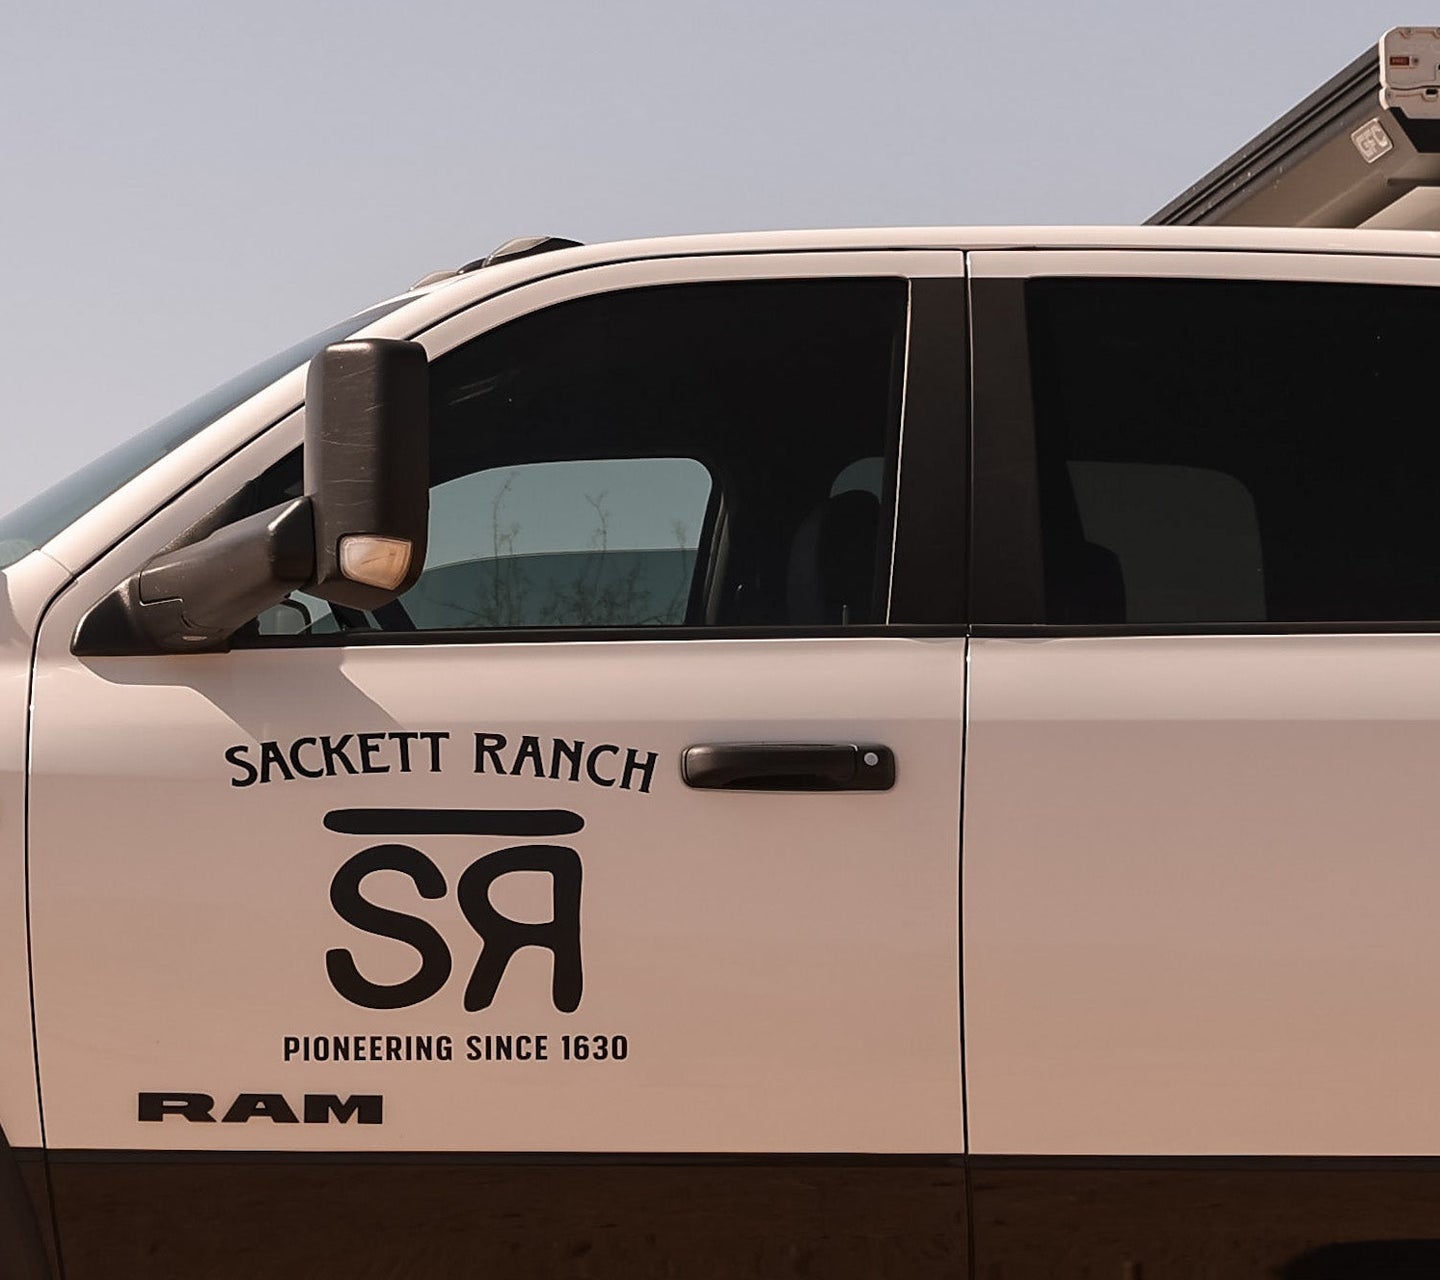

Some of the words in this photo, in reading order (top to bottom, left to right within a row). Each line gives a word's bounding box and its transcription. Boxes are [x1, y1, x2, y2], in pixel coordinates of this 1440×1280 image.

[224, 731, 450, 788] SACKETT
[472, 732, 660, 794] RANCH
[283, 1035, 453, 1062] PIONEERING
[466, 1035, 549, 1061] SINCE
[561, 1035, 628, 1061] 1630
[138, 1092, 384, 1125] RAM
